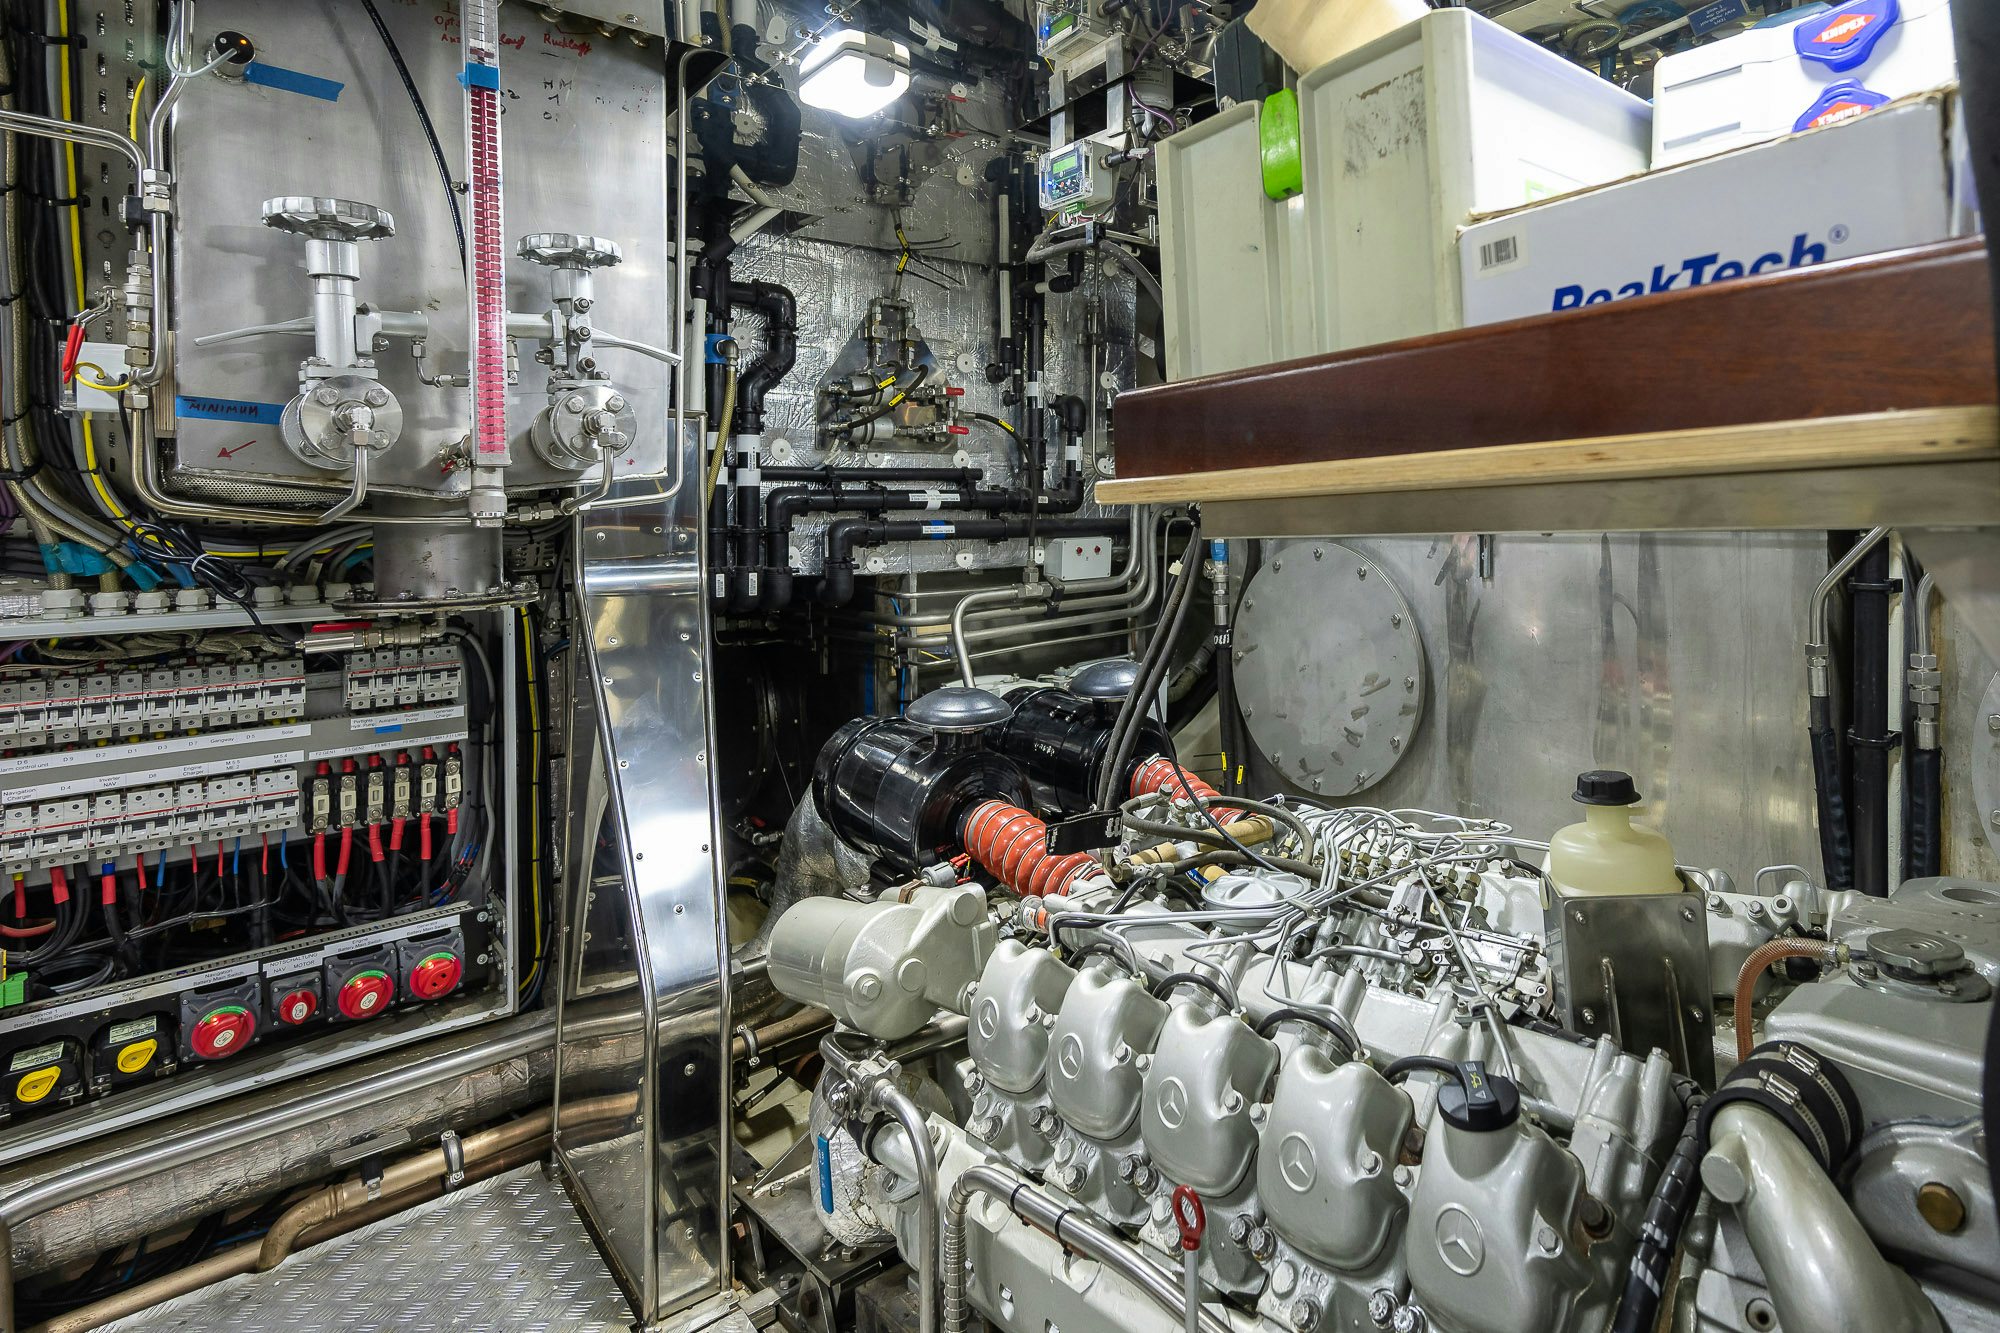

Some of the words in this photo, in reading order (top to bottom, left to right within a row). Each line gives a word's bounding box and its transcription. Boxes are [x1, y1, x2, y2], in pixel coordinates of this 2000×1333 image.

[1821, 16, 1866, 42] KNIPEX
[188, 402, 258, 417] MINIMUM
[16, 763, 36, 771] control
[3, 788, 36, 797] Navigation
[7, 794, 32, 802] Charger
[407, 928, 423, 936] Battery
[338, 945, 354, 953] Battery
[269, 953, 318, 967] NOTSCHALTUNG
[293, 960, 315, 969] MOTOR
[205, 969, 233, 978] Navigation
[193, 978, 211, 986] Battery
[212, 975, 226, 983] Main
[227, 971, 244, 979] Switch
[30, 1010, 53, 1019] Service
[14, 1020, 35, 1029] Battery
[37, 1016, 53, 1024] Main
[54, 1011, 74, 1019] Switch
